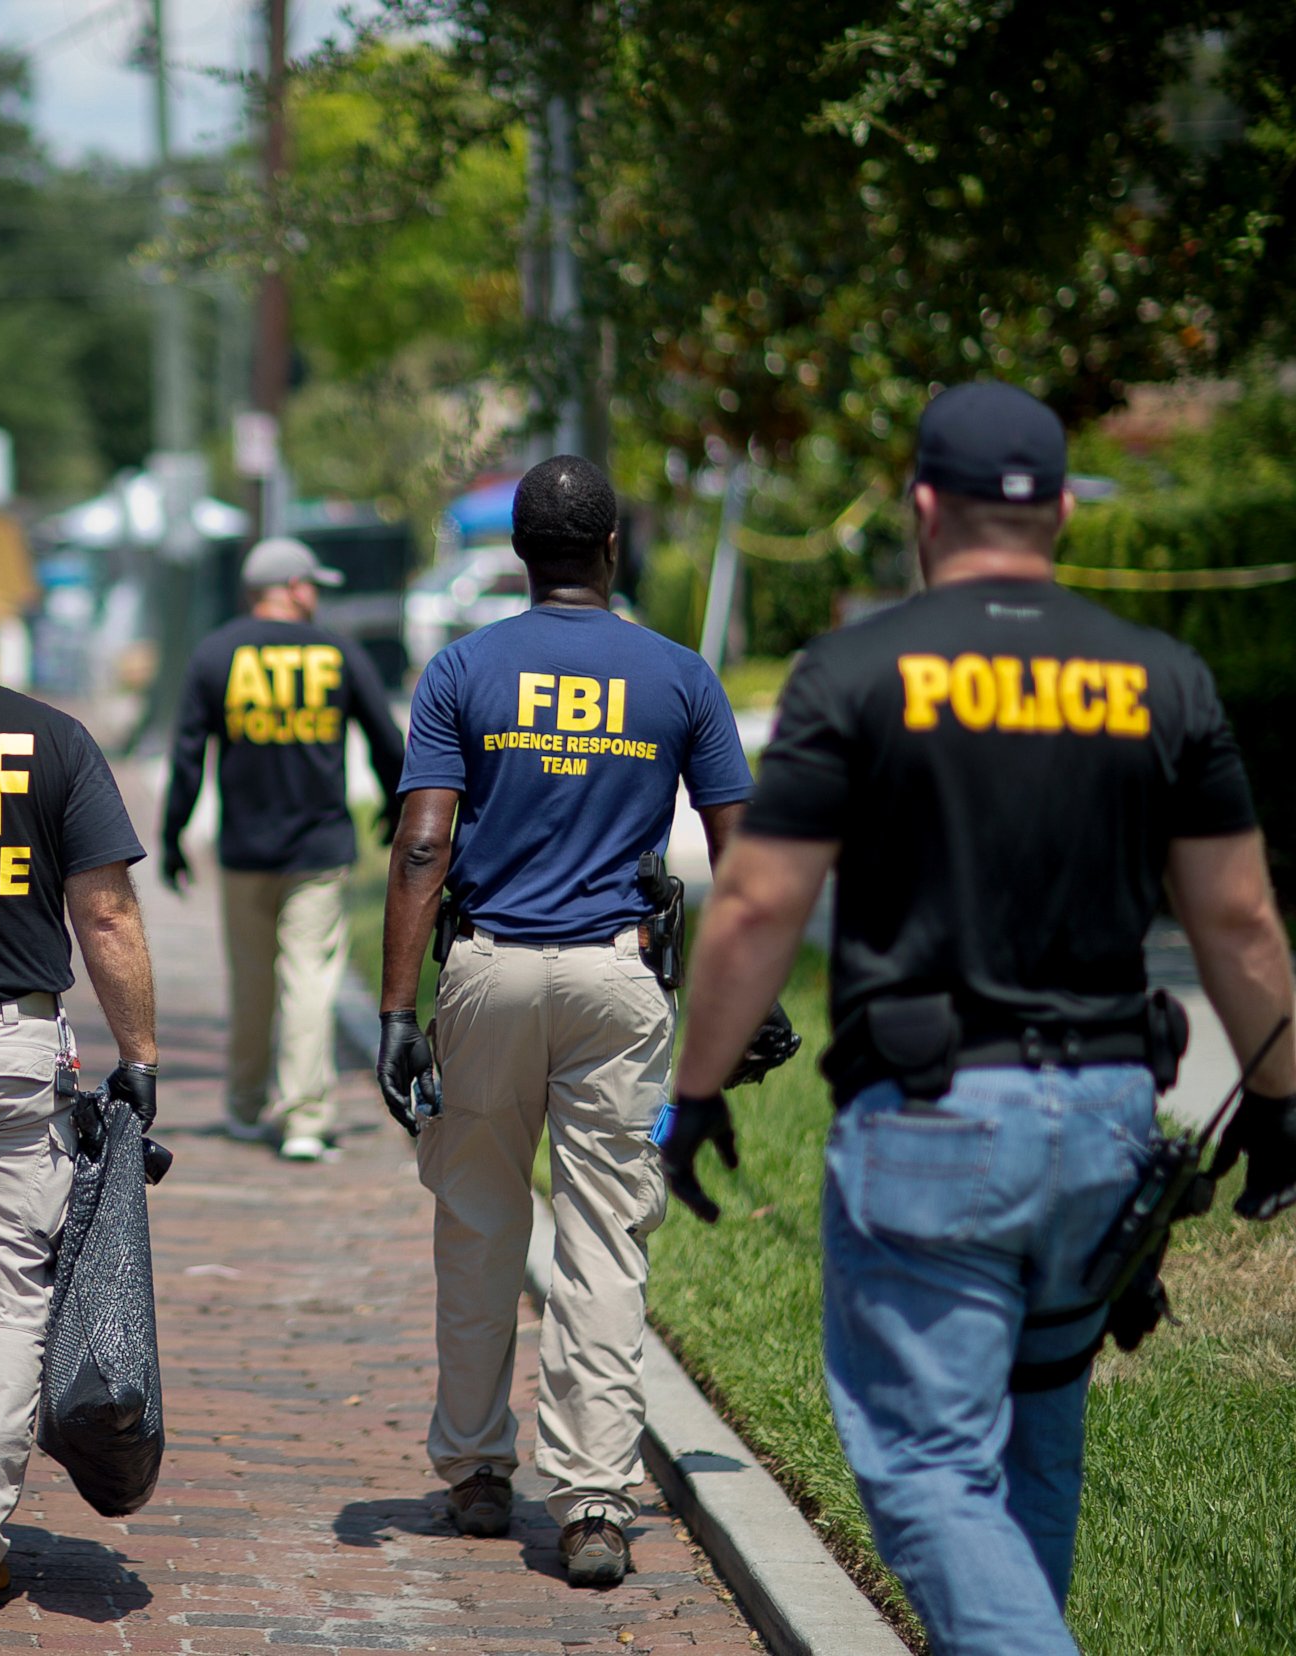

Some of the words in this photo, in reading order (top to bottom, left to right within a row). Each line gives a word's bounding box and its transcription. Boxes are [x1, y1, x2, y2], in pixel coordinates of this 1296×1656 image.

[224, 645, 343, 708] ATF
[517, 672, 626, 733] FBI
[898, 654, 1150, 737] POLICE
[483, 732, 563, 751] EVIDENCE
[566, 736, 658, 760] RESPONSE
[540, 756, 587, 776] TEAM
